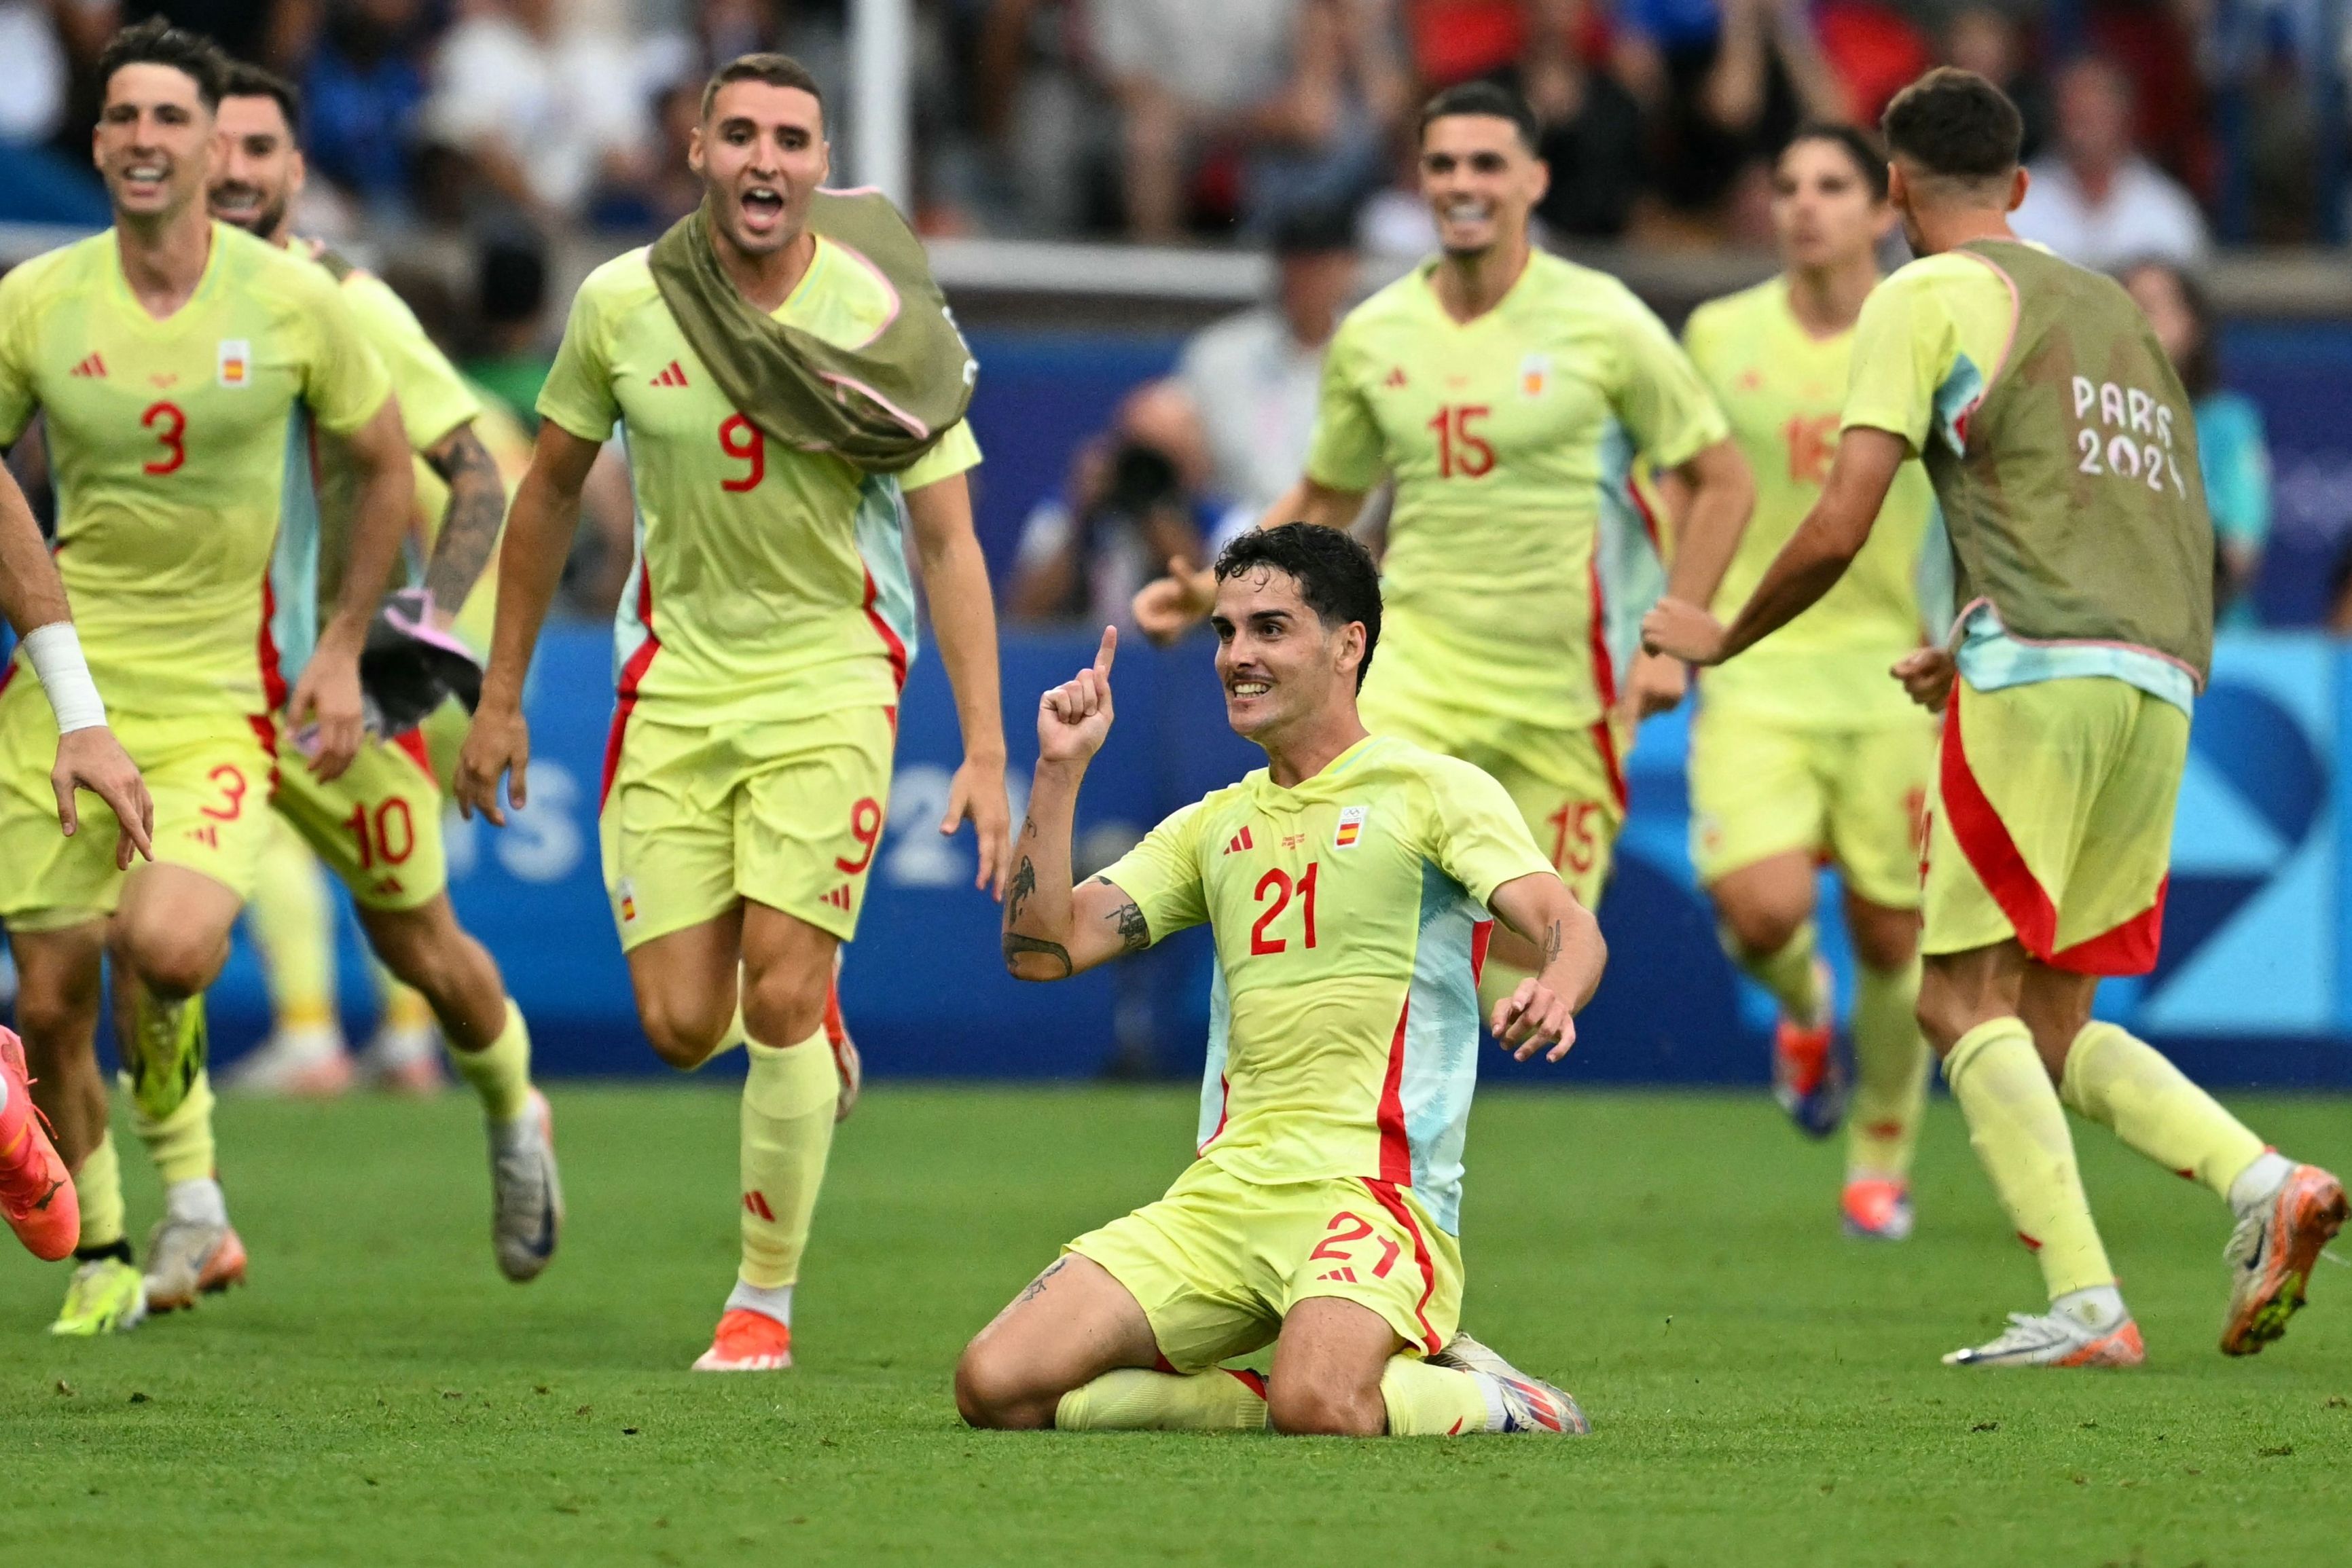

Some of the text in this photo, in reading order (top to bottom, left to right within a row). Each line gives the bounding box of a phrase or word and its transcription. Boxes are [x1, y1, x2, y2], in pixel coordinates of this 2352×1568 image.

[141, 401, 187, 475] 3
[719, 412, 765, 492] 9
[1428, 405, 1496, 478] 15
[200, 763, 248, 822] 3
[345, 796, 416, 869] 10
[835, 797, 884, 876] 9
[1549, 800, 1600, 875] 15
[1250, 862, 1319, 957] 21
[1309, 1211, 1401, 1279] 21
